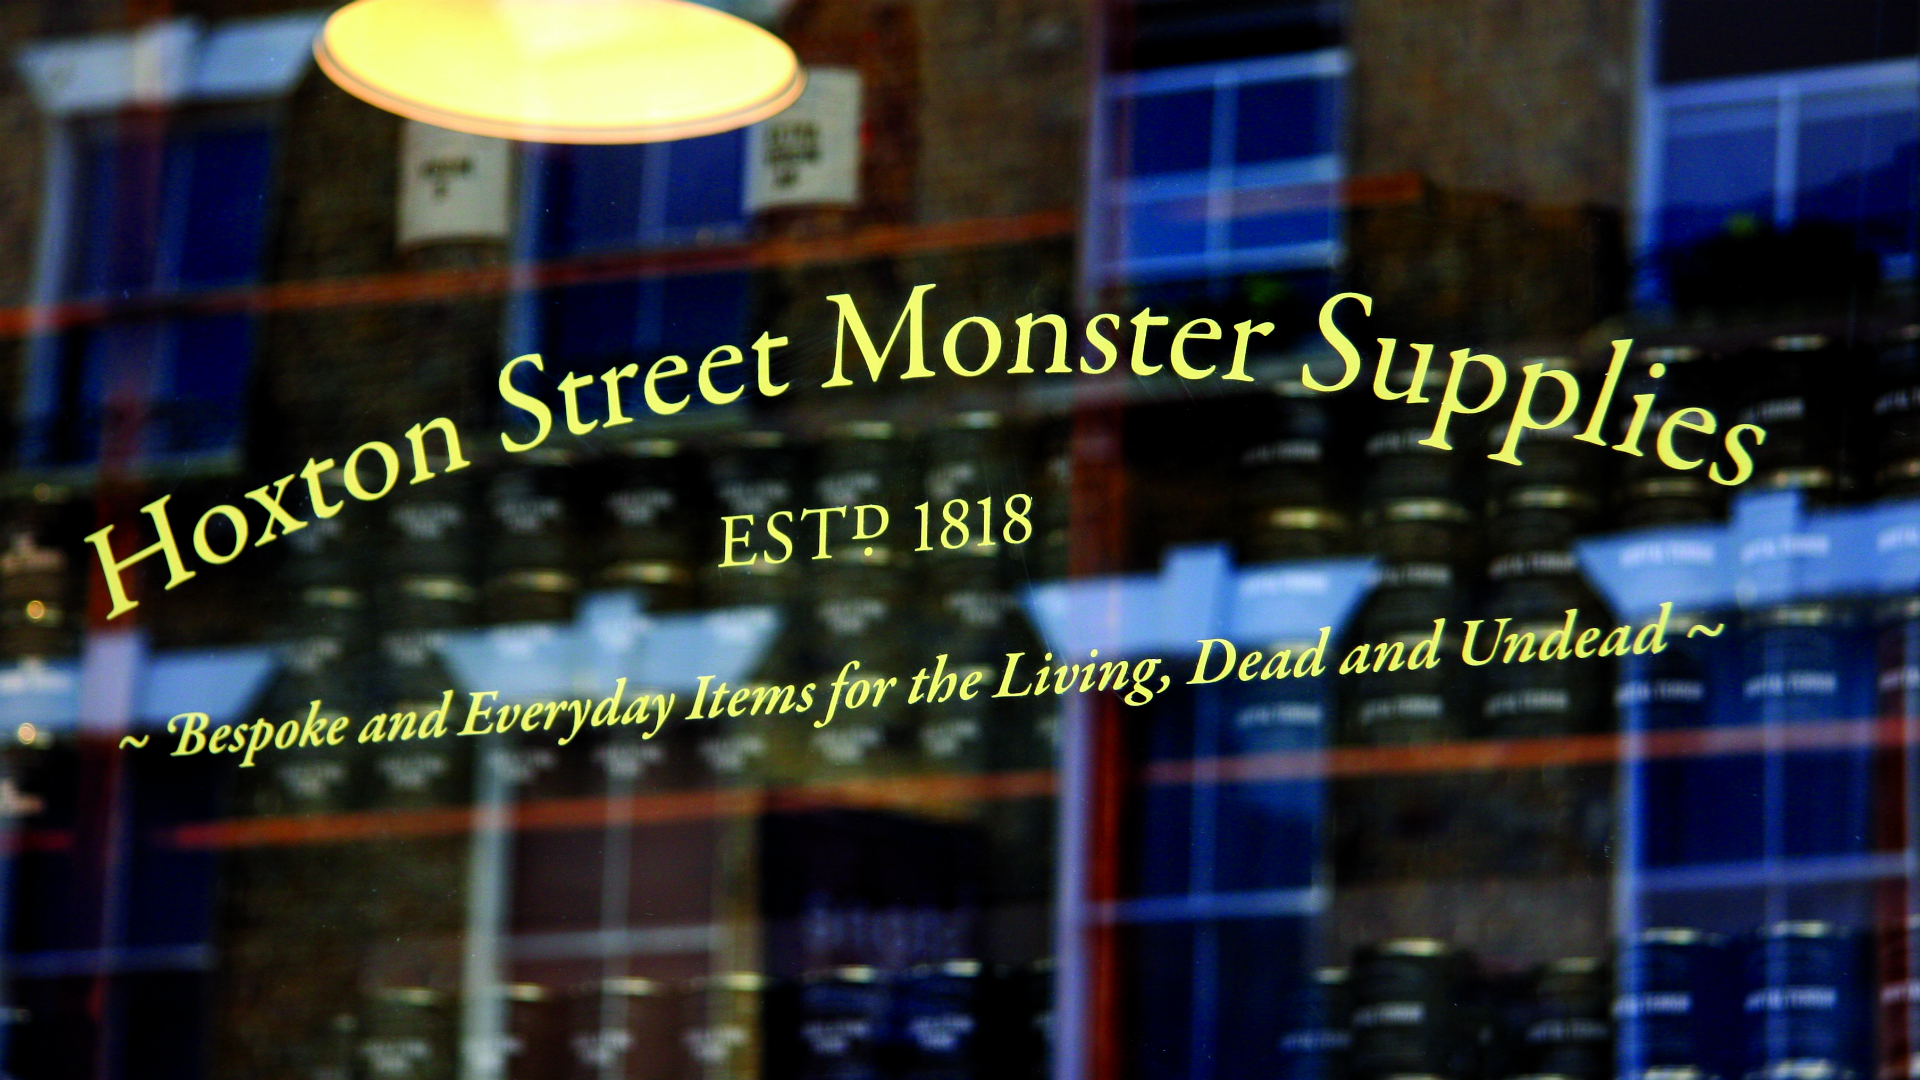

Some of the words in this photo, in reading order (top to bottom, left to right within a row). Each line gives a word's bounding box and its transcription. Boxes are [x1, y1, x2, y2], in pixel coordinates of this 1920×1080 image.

[85, 417, 471, 620] Hoxton
[499, 330, 790, 453] Street
[822, 284, 1275, 388] Monster
[1301, 292, 1766, 486] Supplies
[914, 493, 1034, 553] 1818
[166, 699, 347, 768] Bespoke
[358, 689, 454, 744] and
[457, 677, 676, 746] Everyday
[685, 674, 817, 720] Items
[813, 660, 898, 730] for
[907, 653, 983, 704] the
[991, 649, 1171, 706] Living,
[1186, 627, 1330, 684] Dead
[1338, 617, 1446, 679] and
[1461, 602, 1672, 666] Undead
